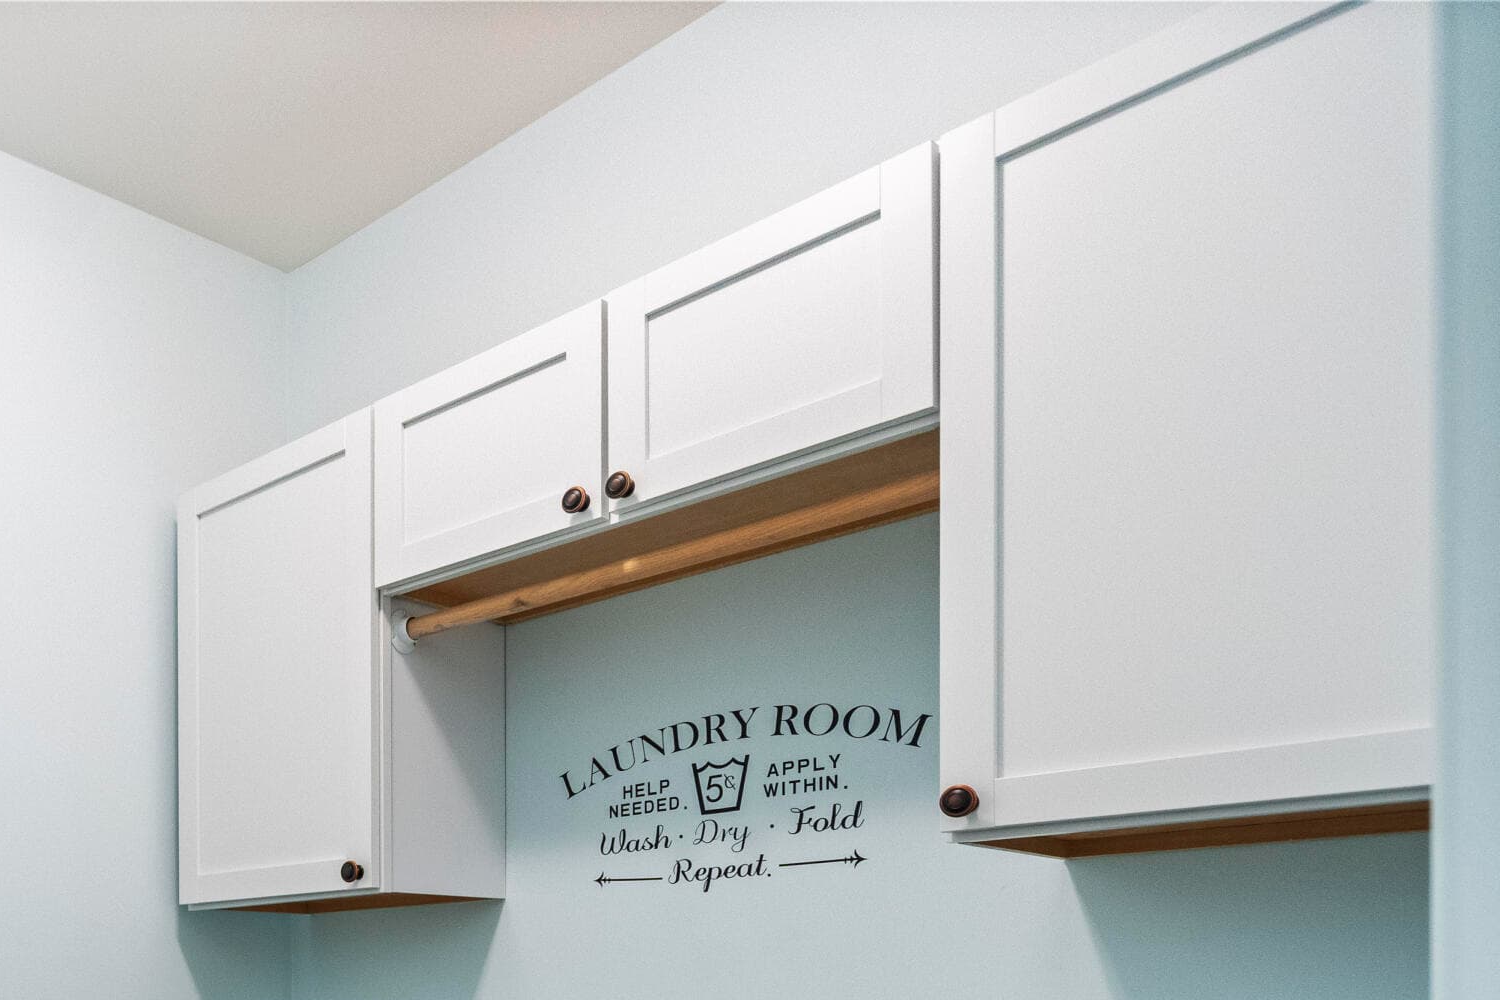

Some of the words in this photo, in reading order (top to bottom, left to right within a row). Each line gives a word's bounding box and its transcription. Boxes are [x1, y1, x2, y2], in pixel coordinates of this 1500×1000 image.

[559, 706, 760, 799] LAUNDRY
[770, 702, 933, 748] ROOM
[766, 753, 842, 778] APPLY
[622, 779, 671, 800] HELP
[763, 774, 849, 798] WITHIN.
[608, 797, 688, 819] NEEDED.
[599, 824, 673, 856] Wash
[692, 819, 751, 853] Dry
[788, 800, 865, 835] Fold
[667, 853, 773, 893] Repeat.
